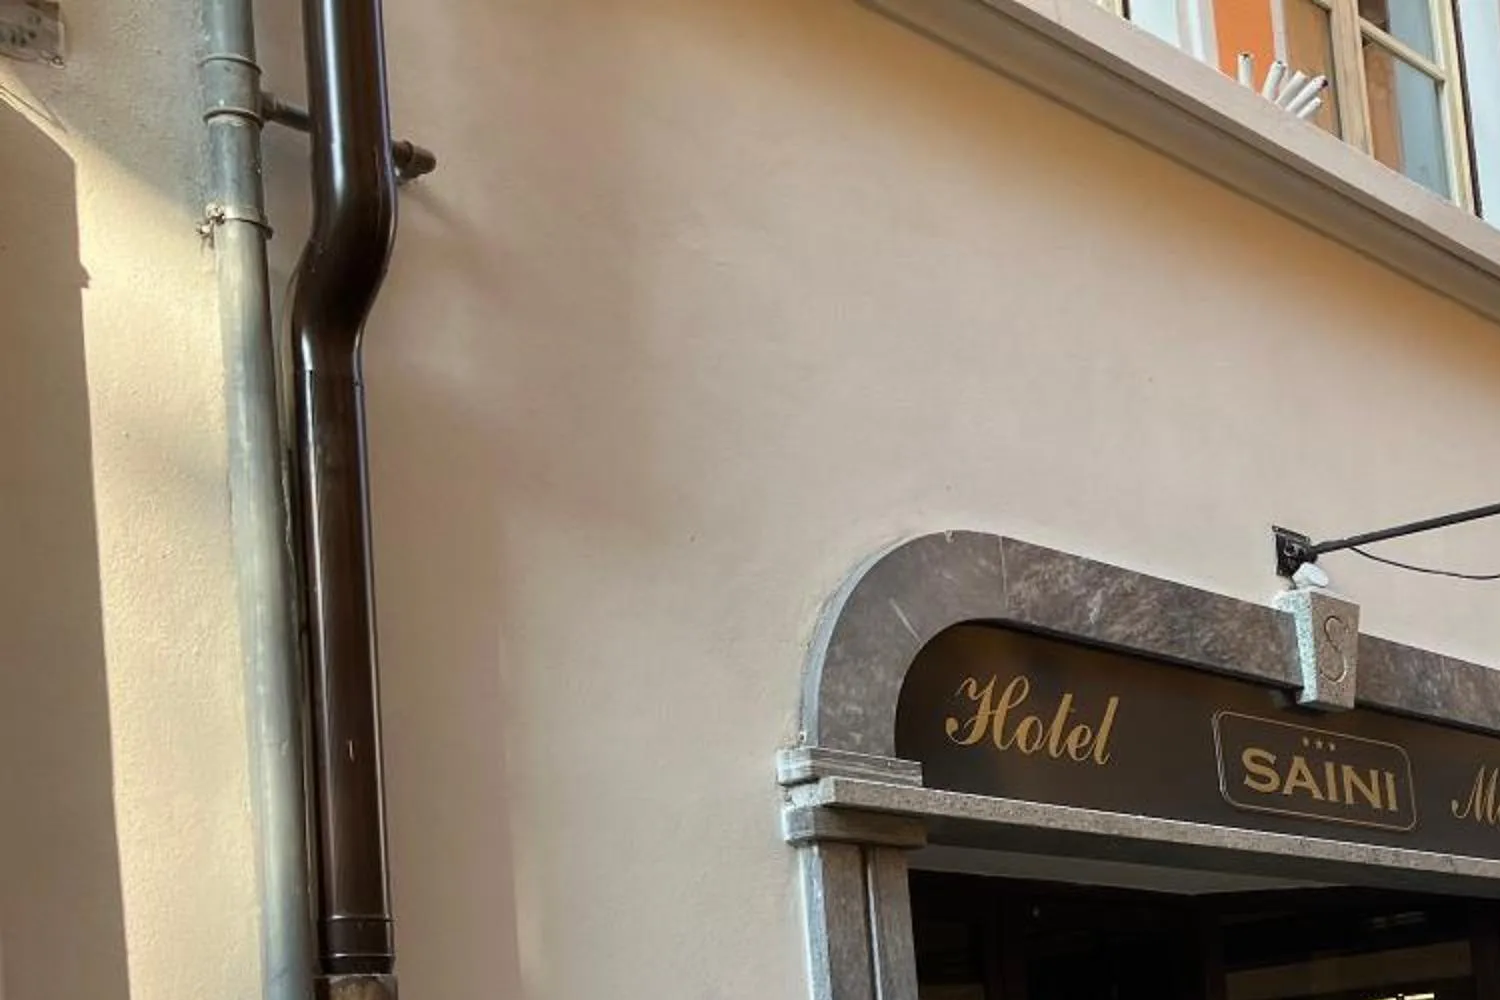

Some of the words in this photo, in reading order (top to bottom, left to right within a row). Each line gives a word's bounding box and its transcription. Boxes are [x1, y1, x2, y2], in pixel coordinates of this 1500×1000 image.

[1317, 615, 1350, 684] S
[945, 674, 1120, 765] Hotel
[1241, 746, 1399, 812] SAINI
